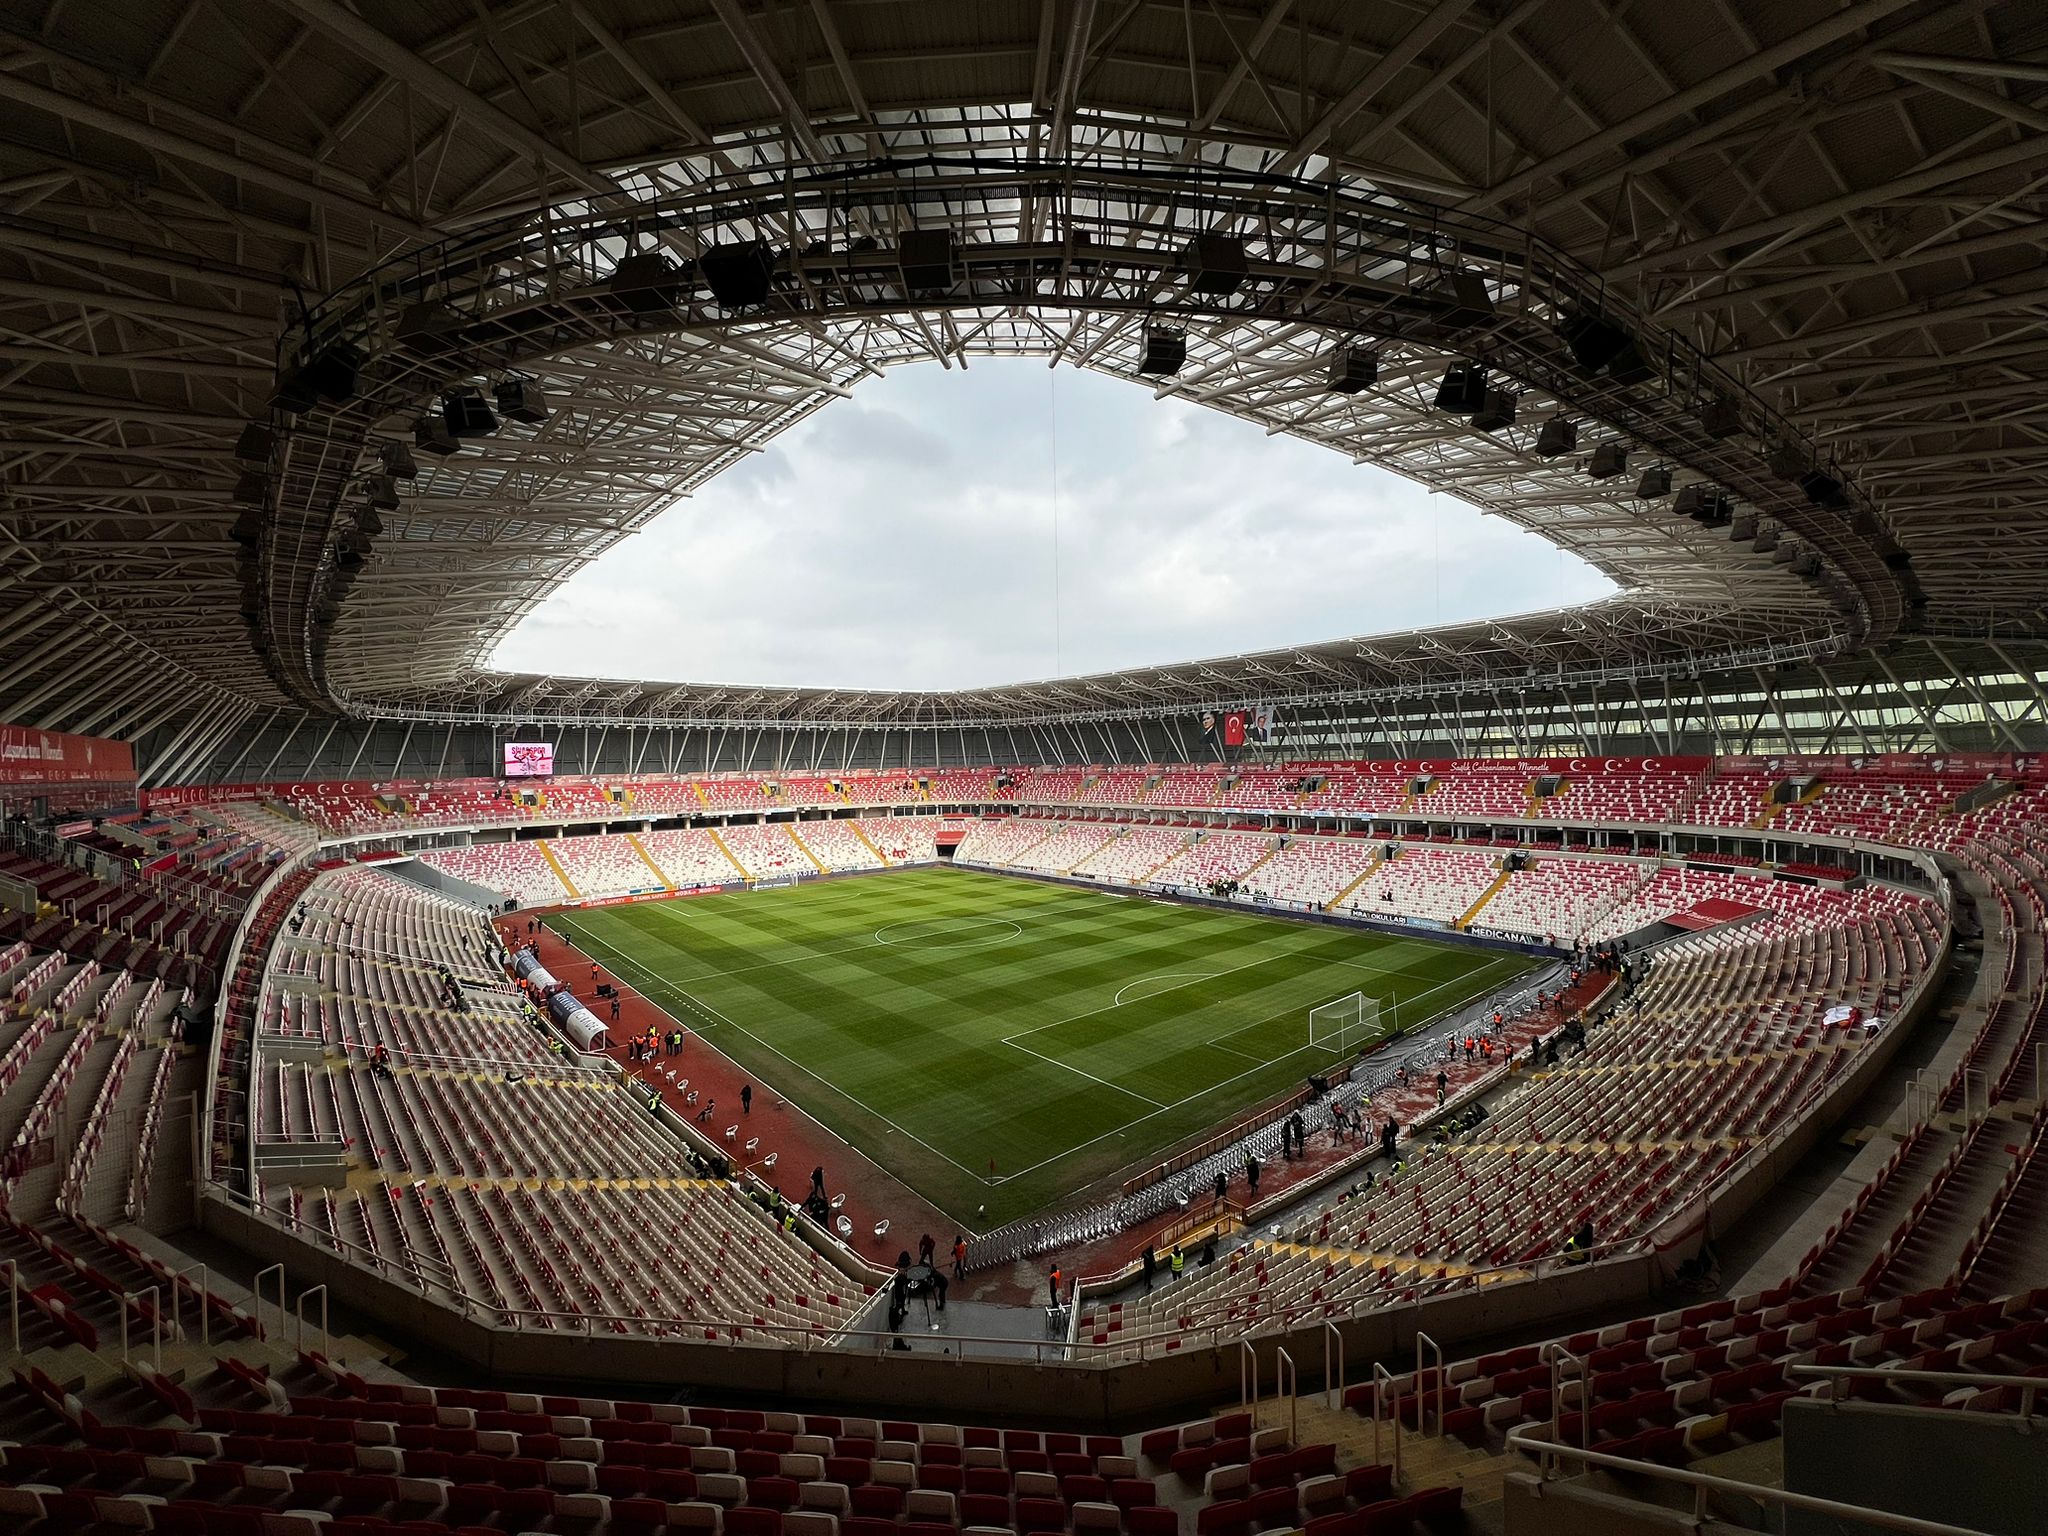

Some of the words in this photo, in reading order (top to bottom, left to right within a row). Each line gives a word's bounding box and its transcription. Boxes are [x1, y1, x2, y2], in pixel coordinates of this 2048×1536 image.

[1518, 761, 1549, 771] Minnetle
[1371, 913, 1406, 923] OKULLARI
[1471, 927, 1528, 945] MEDICANA
